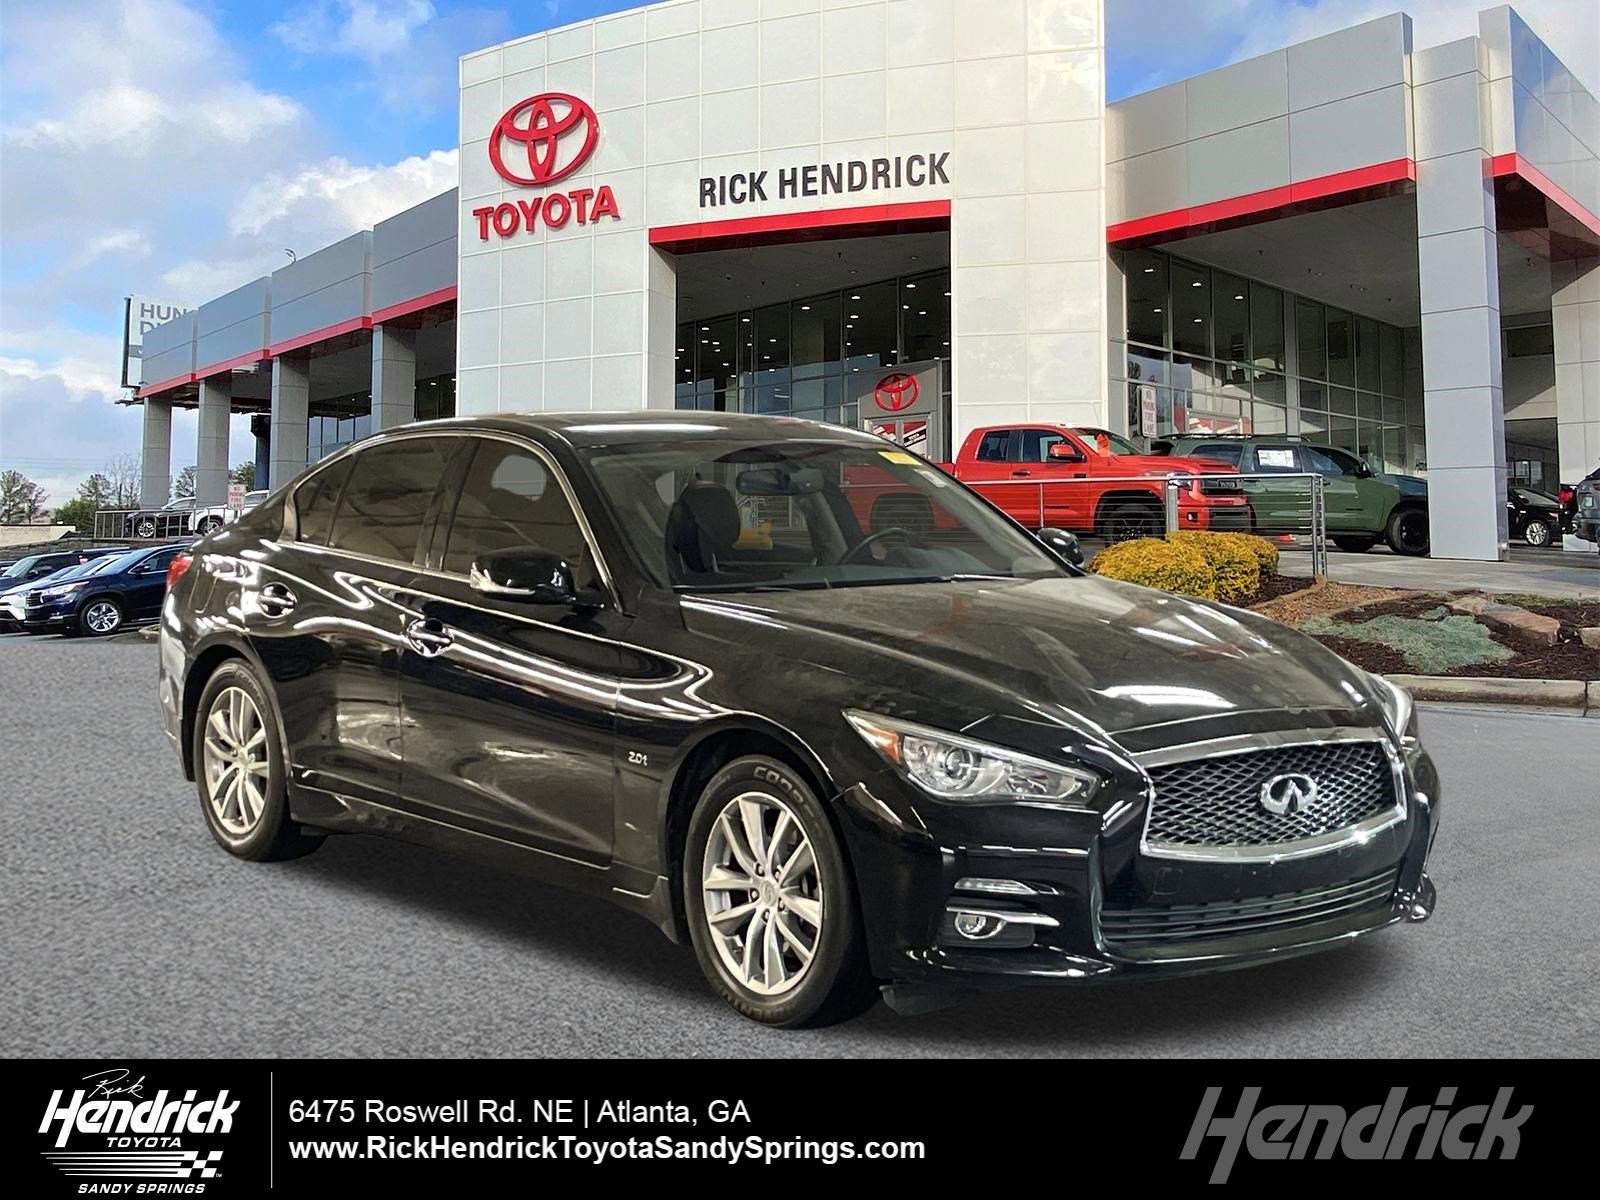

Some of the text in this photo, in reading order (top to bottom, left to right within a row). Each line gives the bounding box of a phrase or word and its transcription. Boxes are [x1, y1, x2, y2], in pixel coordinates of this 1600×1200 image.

[699, 153, 951, 208] RICK HENDRICK
[473, 185, 620, 242] TOYOTA
